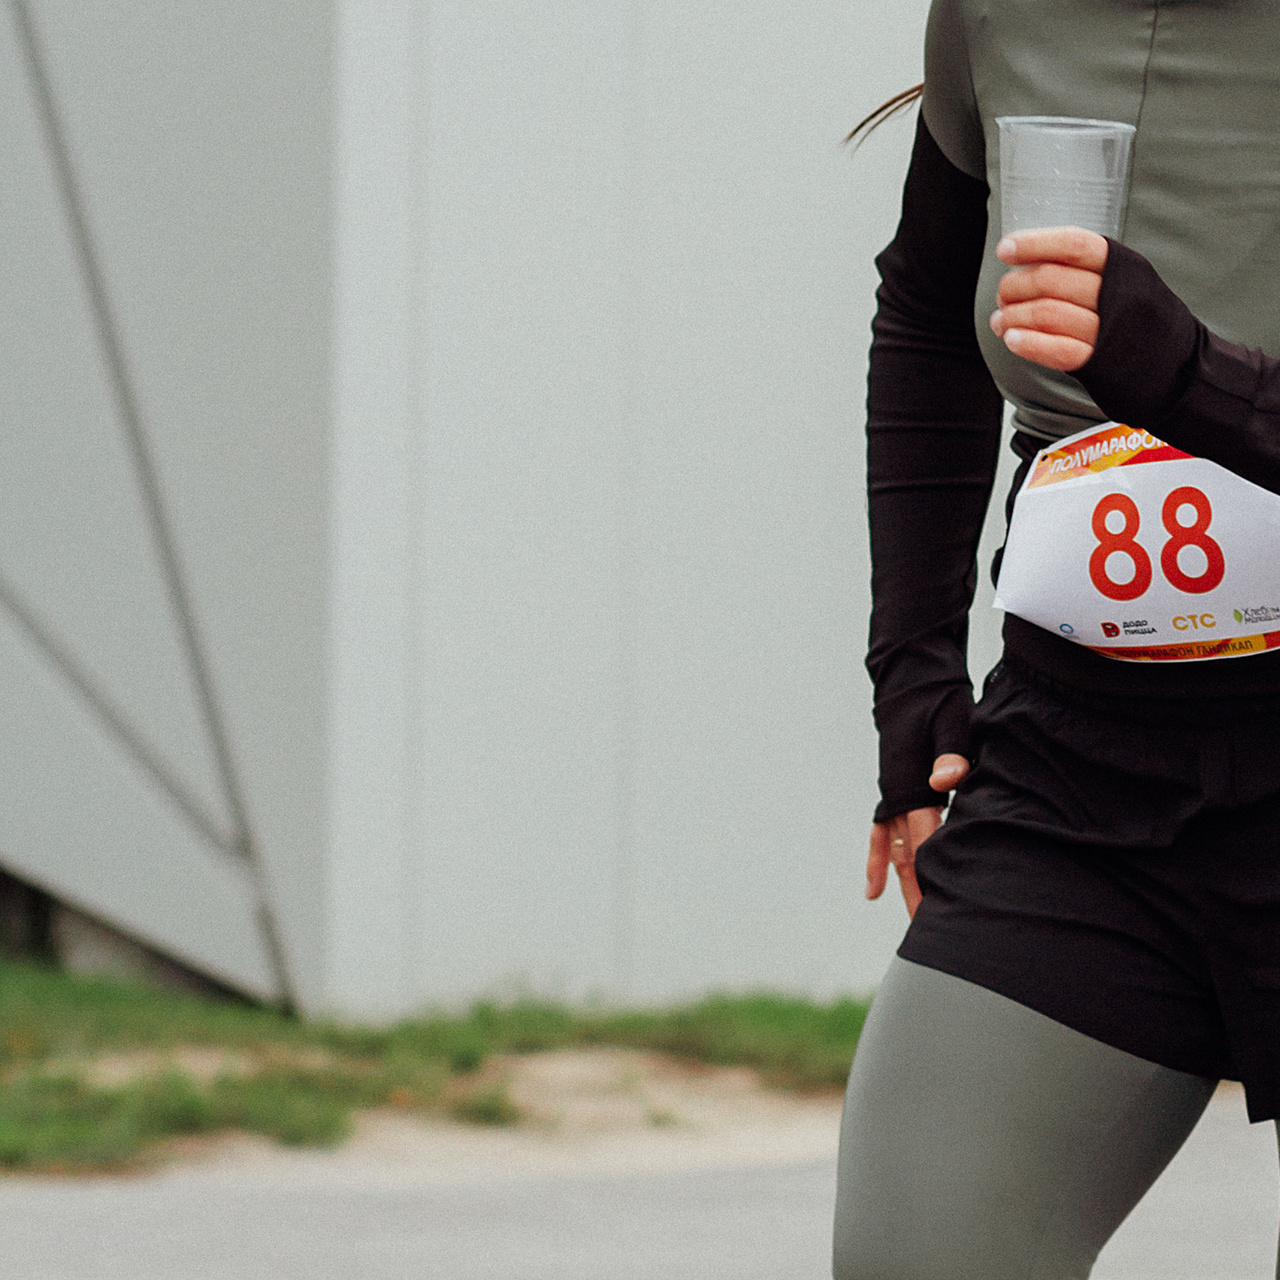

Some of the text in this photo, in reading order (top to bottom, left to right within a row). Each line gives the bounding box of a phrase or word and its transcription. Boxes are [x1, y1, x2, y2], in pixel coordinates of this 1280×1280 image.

[1088, 486, 1225, 601] 88
[1122, 619, 1148, 629] ДОДО
[1124, 627, 1158, 636] ПИЦЦА
[1197, 639, 1254, 655] ГАНДИКАП
